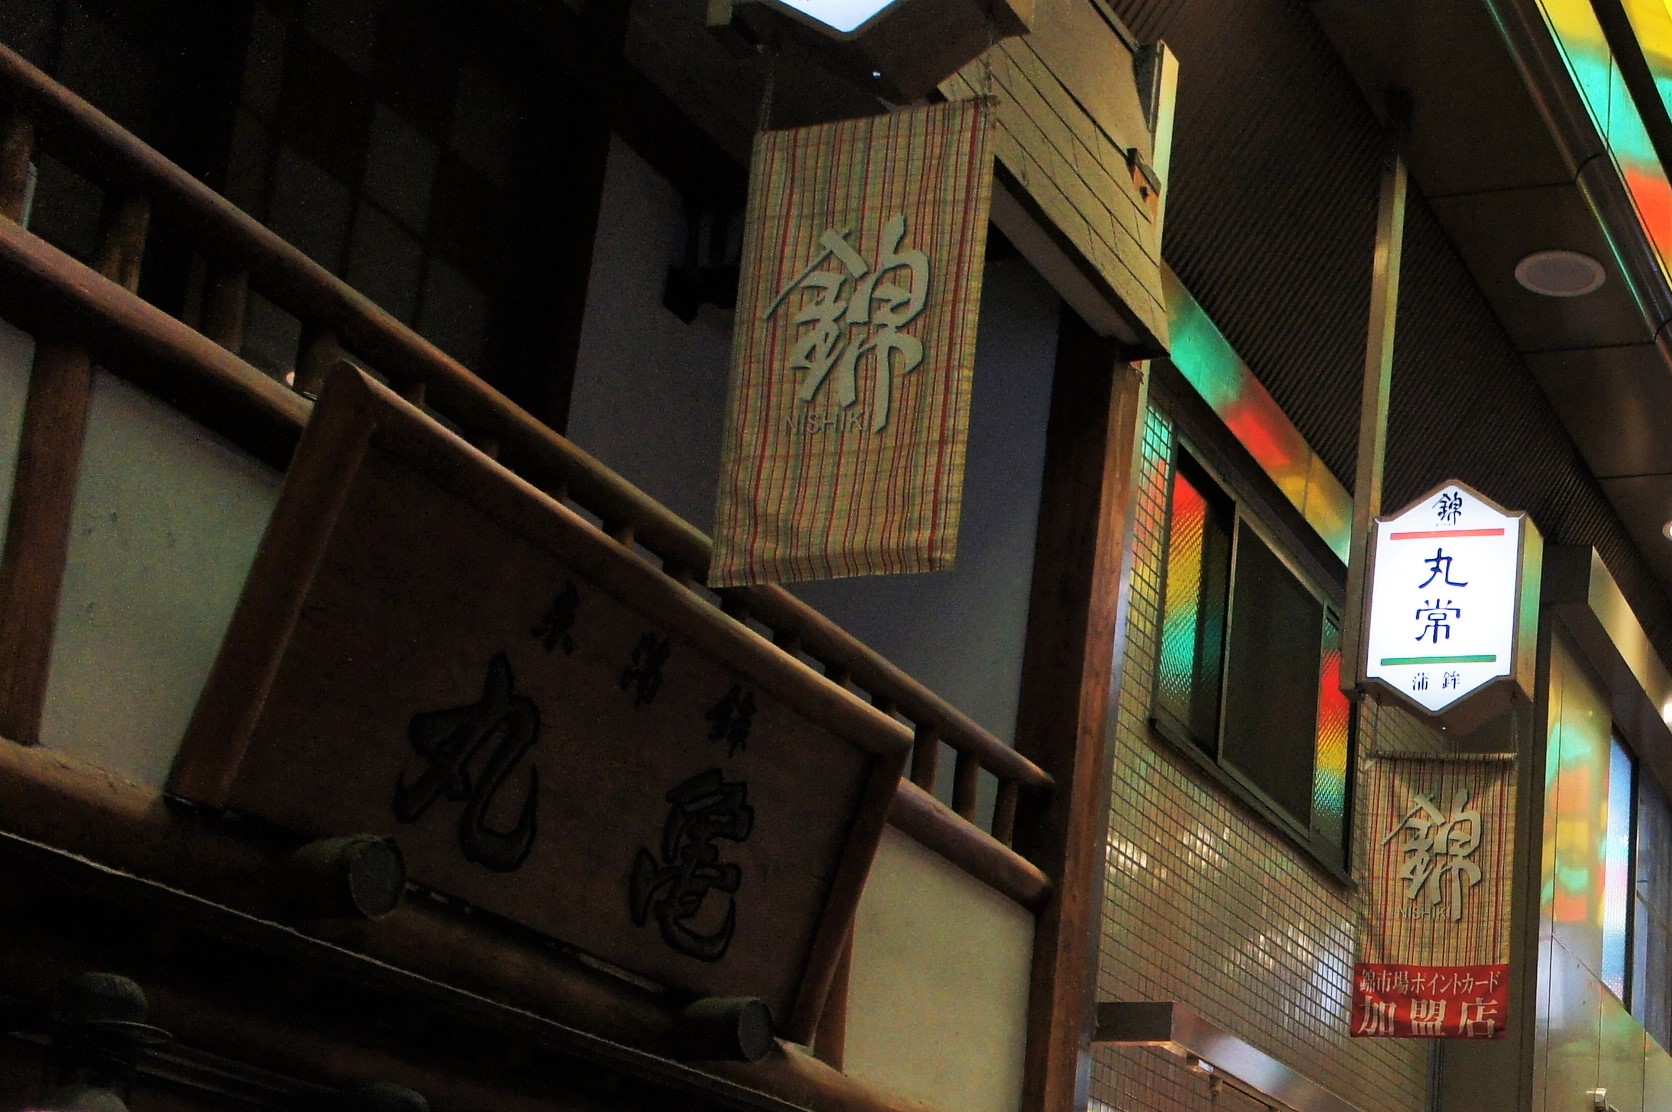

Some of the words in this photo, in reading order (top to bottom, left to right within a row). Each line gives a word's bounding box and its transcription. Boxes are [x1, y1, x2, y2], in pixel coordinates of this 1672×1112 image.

[763, 213, 931, 434] 錦
[1432, 491, 1463, 526] 錦
[1414, 547, 1469, 644] 丸常
[1412, 671, 1461, 692] 蒲鉾
[1381, 788, 1484, 922] 錦
[1359, 969, 1501, 996] 錦市場ポイントカード
[1357, 996, 1499, 1039] 加盟店
